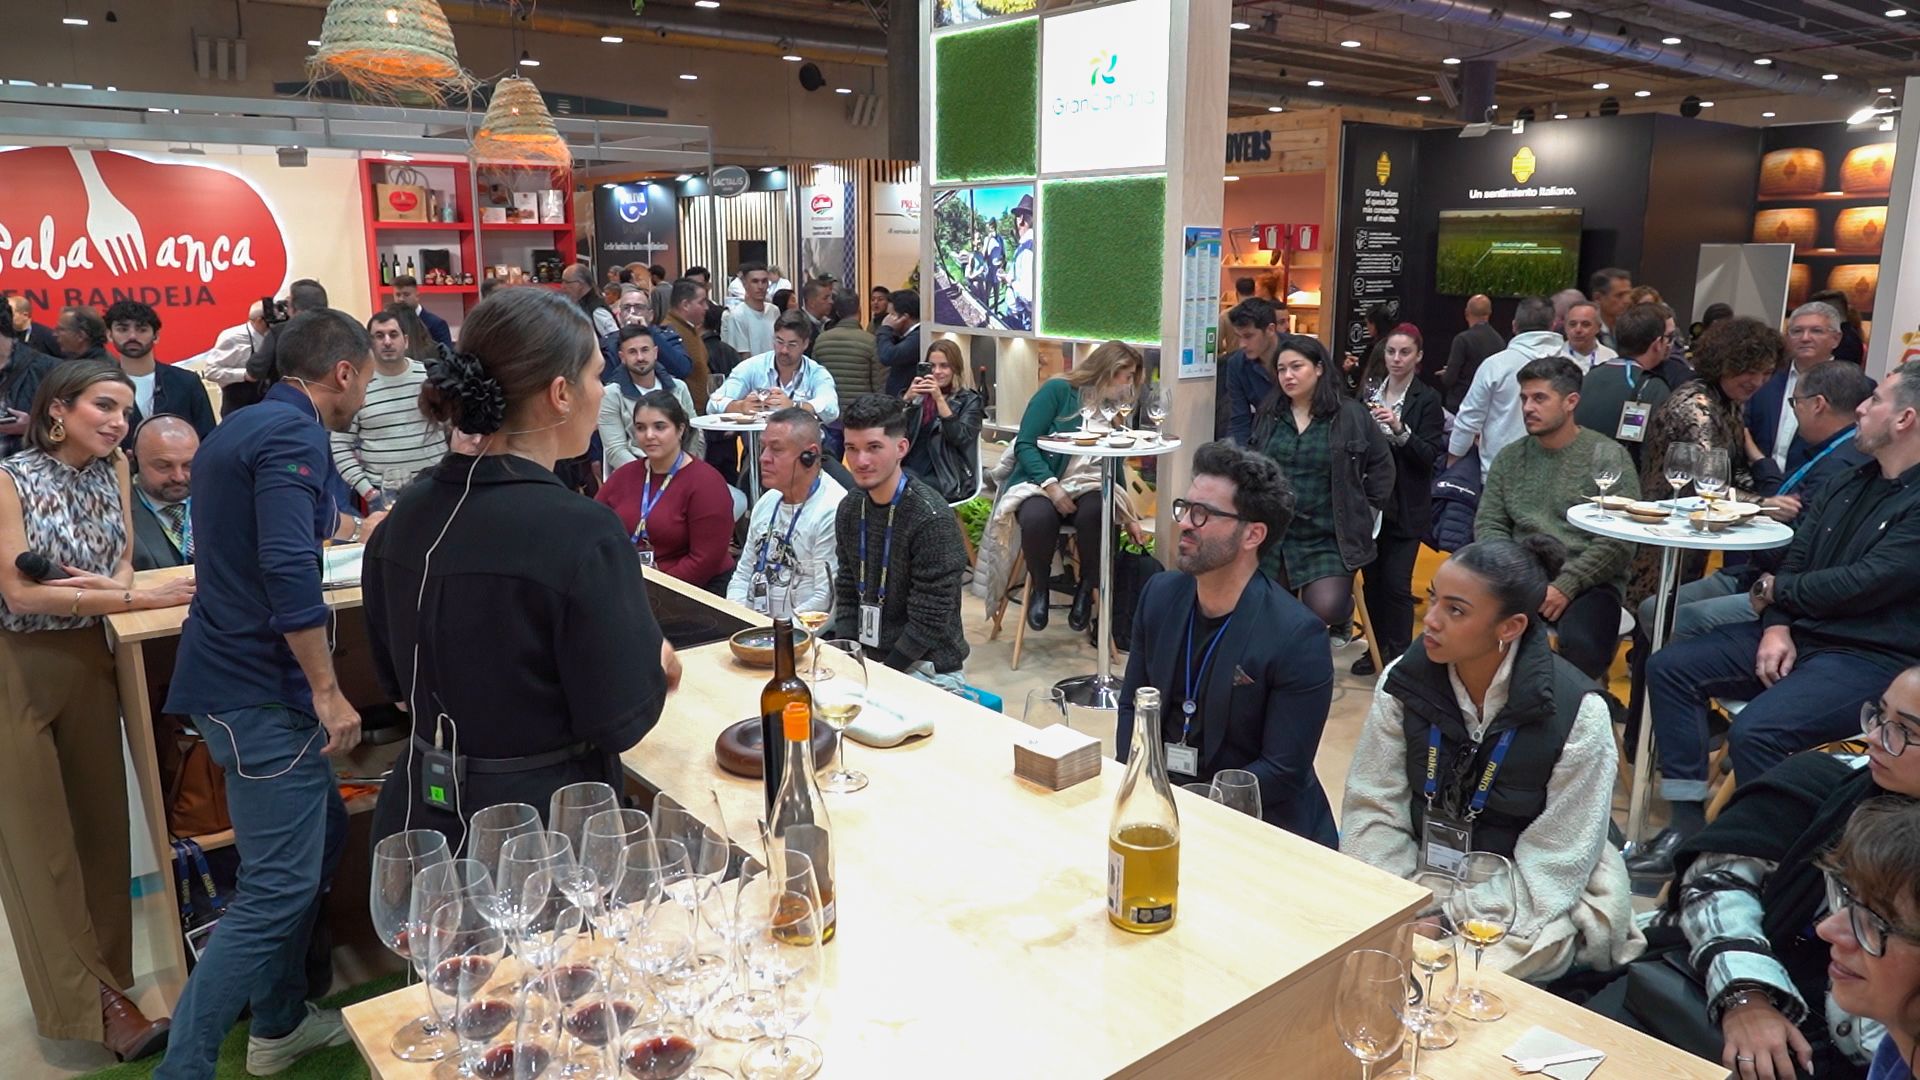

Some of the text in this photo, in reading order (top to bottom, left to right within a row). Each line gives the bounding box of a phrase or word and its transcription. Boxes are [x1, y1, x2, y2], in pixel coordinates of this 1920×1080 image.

[64, 285, 216, 308] BANDEJA
[1426, 746, 1438, 780] makro
[1478, 761, 1498, 792] makro
